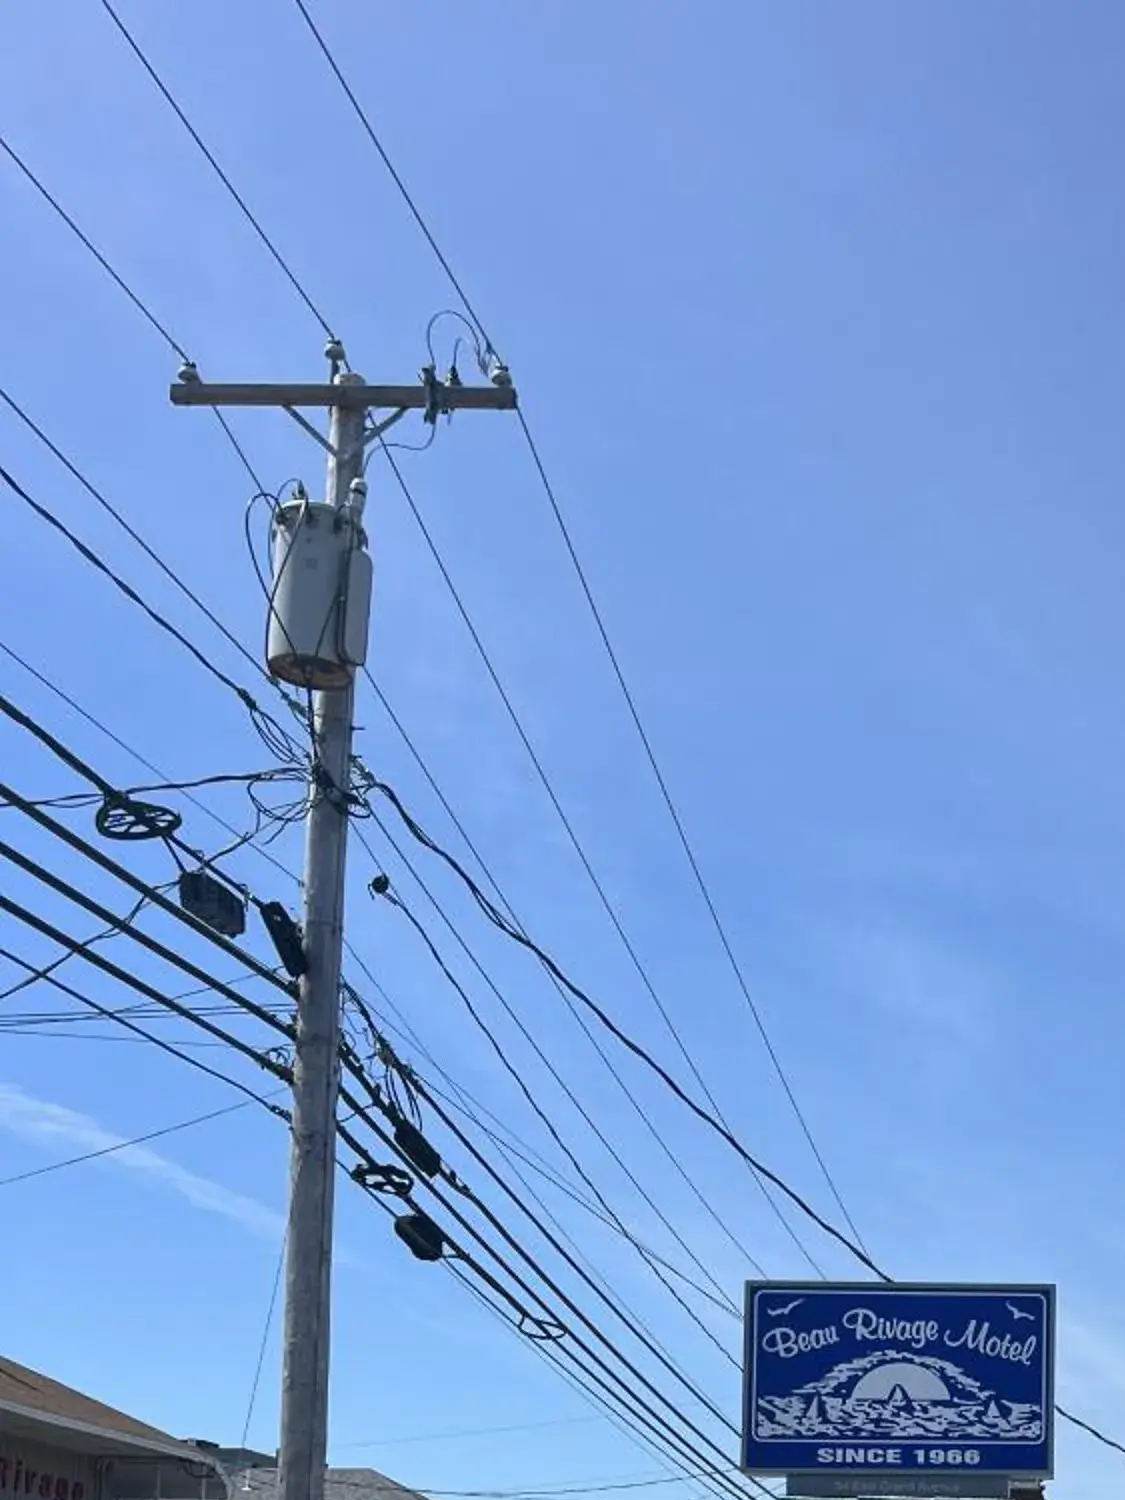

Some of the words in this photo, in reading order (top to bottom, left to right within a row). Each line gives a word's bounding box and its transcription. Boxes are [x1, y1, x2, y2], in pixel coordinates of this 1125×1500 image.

[762, 1324, 840, 1358] Beau
[842, 1307, 939, 1349] Rivage
[944, 1318, 1037, 1365] Motel
[816, 1447, 903, 1464] SINCE
[913, 1448, 981, 1465] 1966
